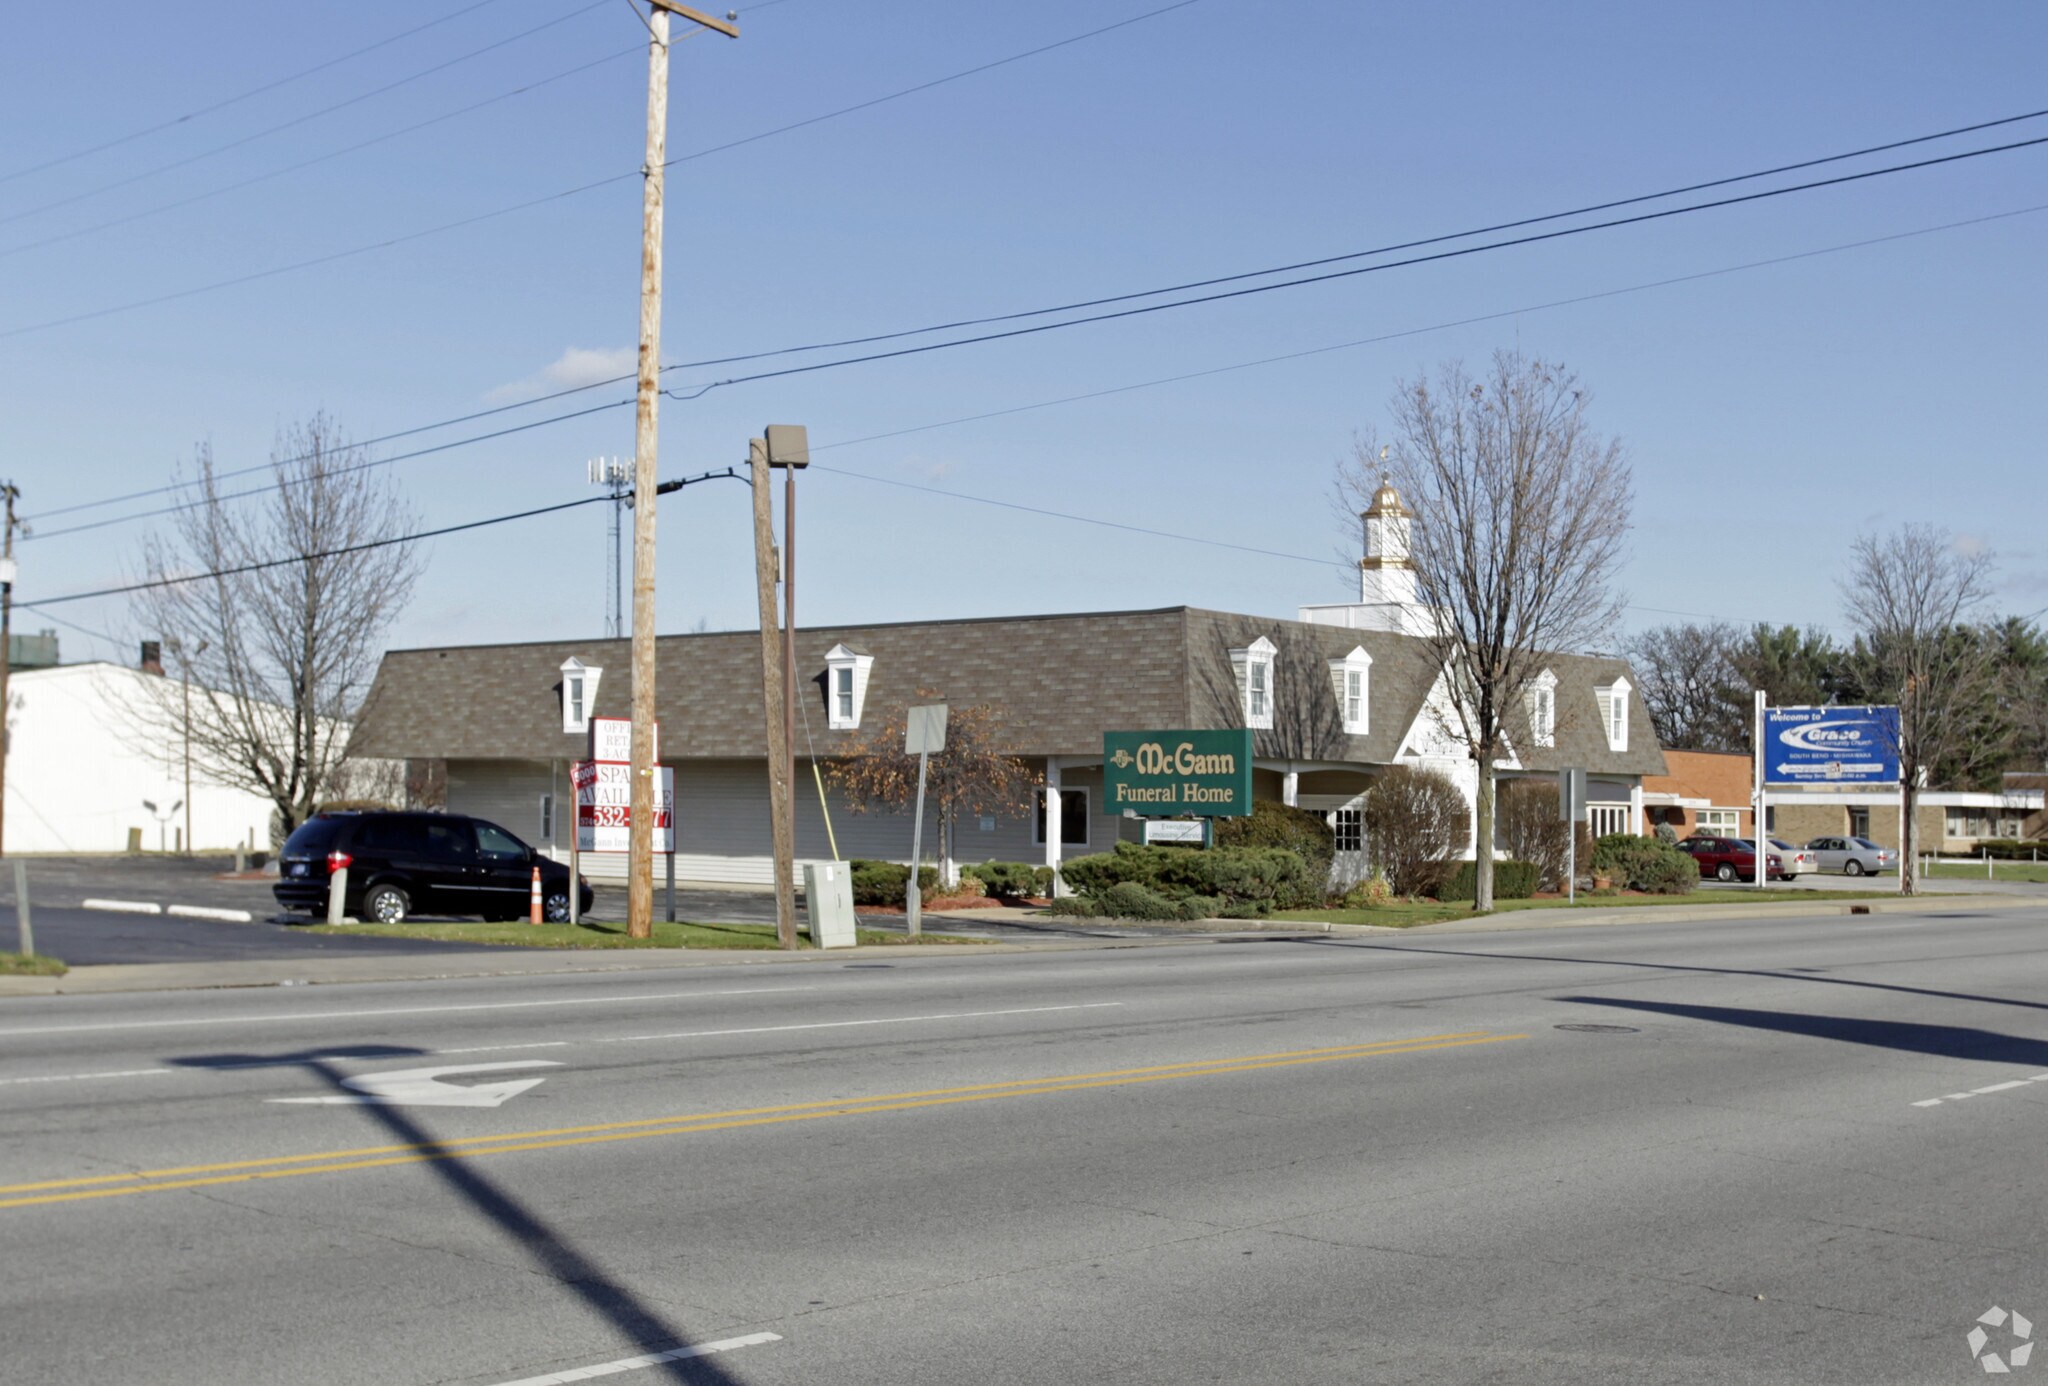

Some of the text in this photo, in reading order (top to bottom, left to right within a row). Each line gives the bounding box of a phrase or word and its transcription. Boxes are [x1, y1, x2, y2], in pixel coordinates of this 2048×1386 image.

[1770, 712, 1821, 721] Welcome to
[604, 722, 630, 733] OFFI
[1807, 729, 1860, 741] Grace
[1136, 742, 1235, 776] McGann
[580, 788, 672, 805] AVAILLE
[1116, 783, 1233, 802] Funeral Home
[1161, 823, 1192, 831] Executive
